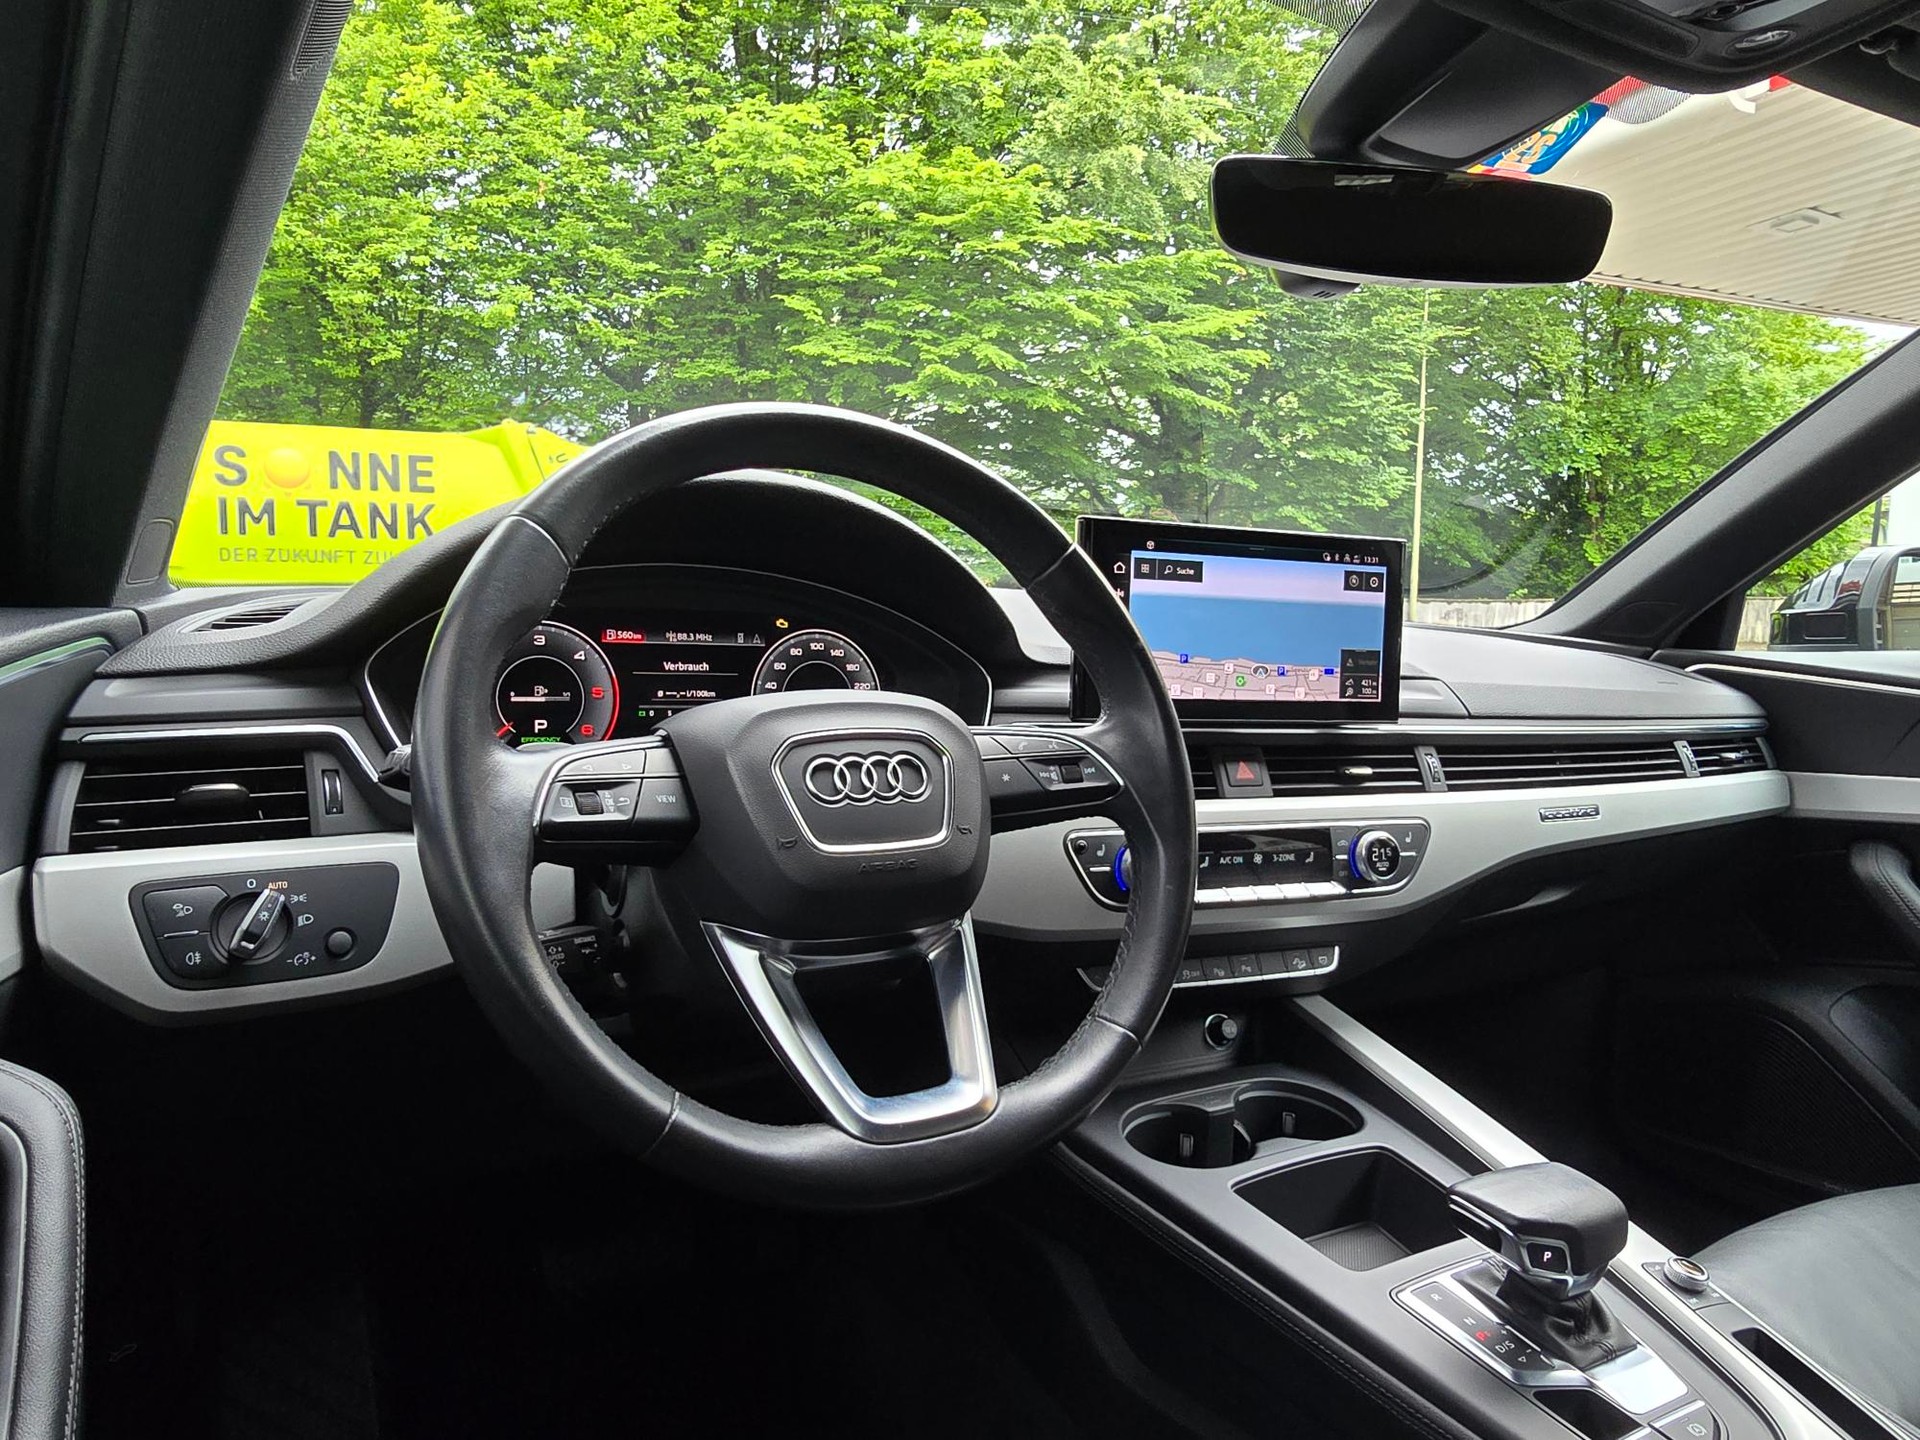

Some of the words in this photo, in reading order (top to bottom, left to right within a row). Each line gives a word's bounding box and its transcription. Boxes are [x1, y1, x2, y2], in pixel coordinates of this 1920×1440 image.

[217, 496, 276, 537] IM
[295, 499, 436, 540] TANK
[218, 547, 258, 563] DER
[265, 548, 357, 565] ZUKUNFT
[1176, 567, 1195, 576] Suche
[533, 635, 546, 646] 3
[677, 632, 695, 641] 88.3
[695, 633, 713, 642] MHz
[809, 642, 825, 651] 100
[573, 650, 586, 661] 4
[790, 648, 803, 656] 80
[830, 649, 845, 657] 140
[663, 661, 710, 672] Verbrauch
[773, 661, 787, 671] 60
[845, 663, 860, 672] 180
[764, 681, 777, 690] 40
[853, 682, 871, 690] 220
[591, 687, 604, 699] 5
[534, 719, 548, 734] P
[581, 724, 594, 736] 6
[655, 794, 676, 804] VIEW
[1220, 856, 1232, 865] A/C
[1233, 856, 1243, 864] ON
[1272, 853, 1295, 862] 3-ZONE
[267, 881, 288, 890] AUTO
[1543, 1251, 1552, 1262] P
[1430, 1292, 1442, 1302] R
[1494, 1340, 1516, 1354] D/S
